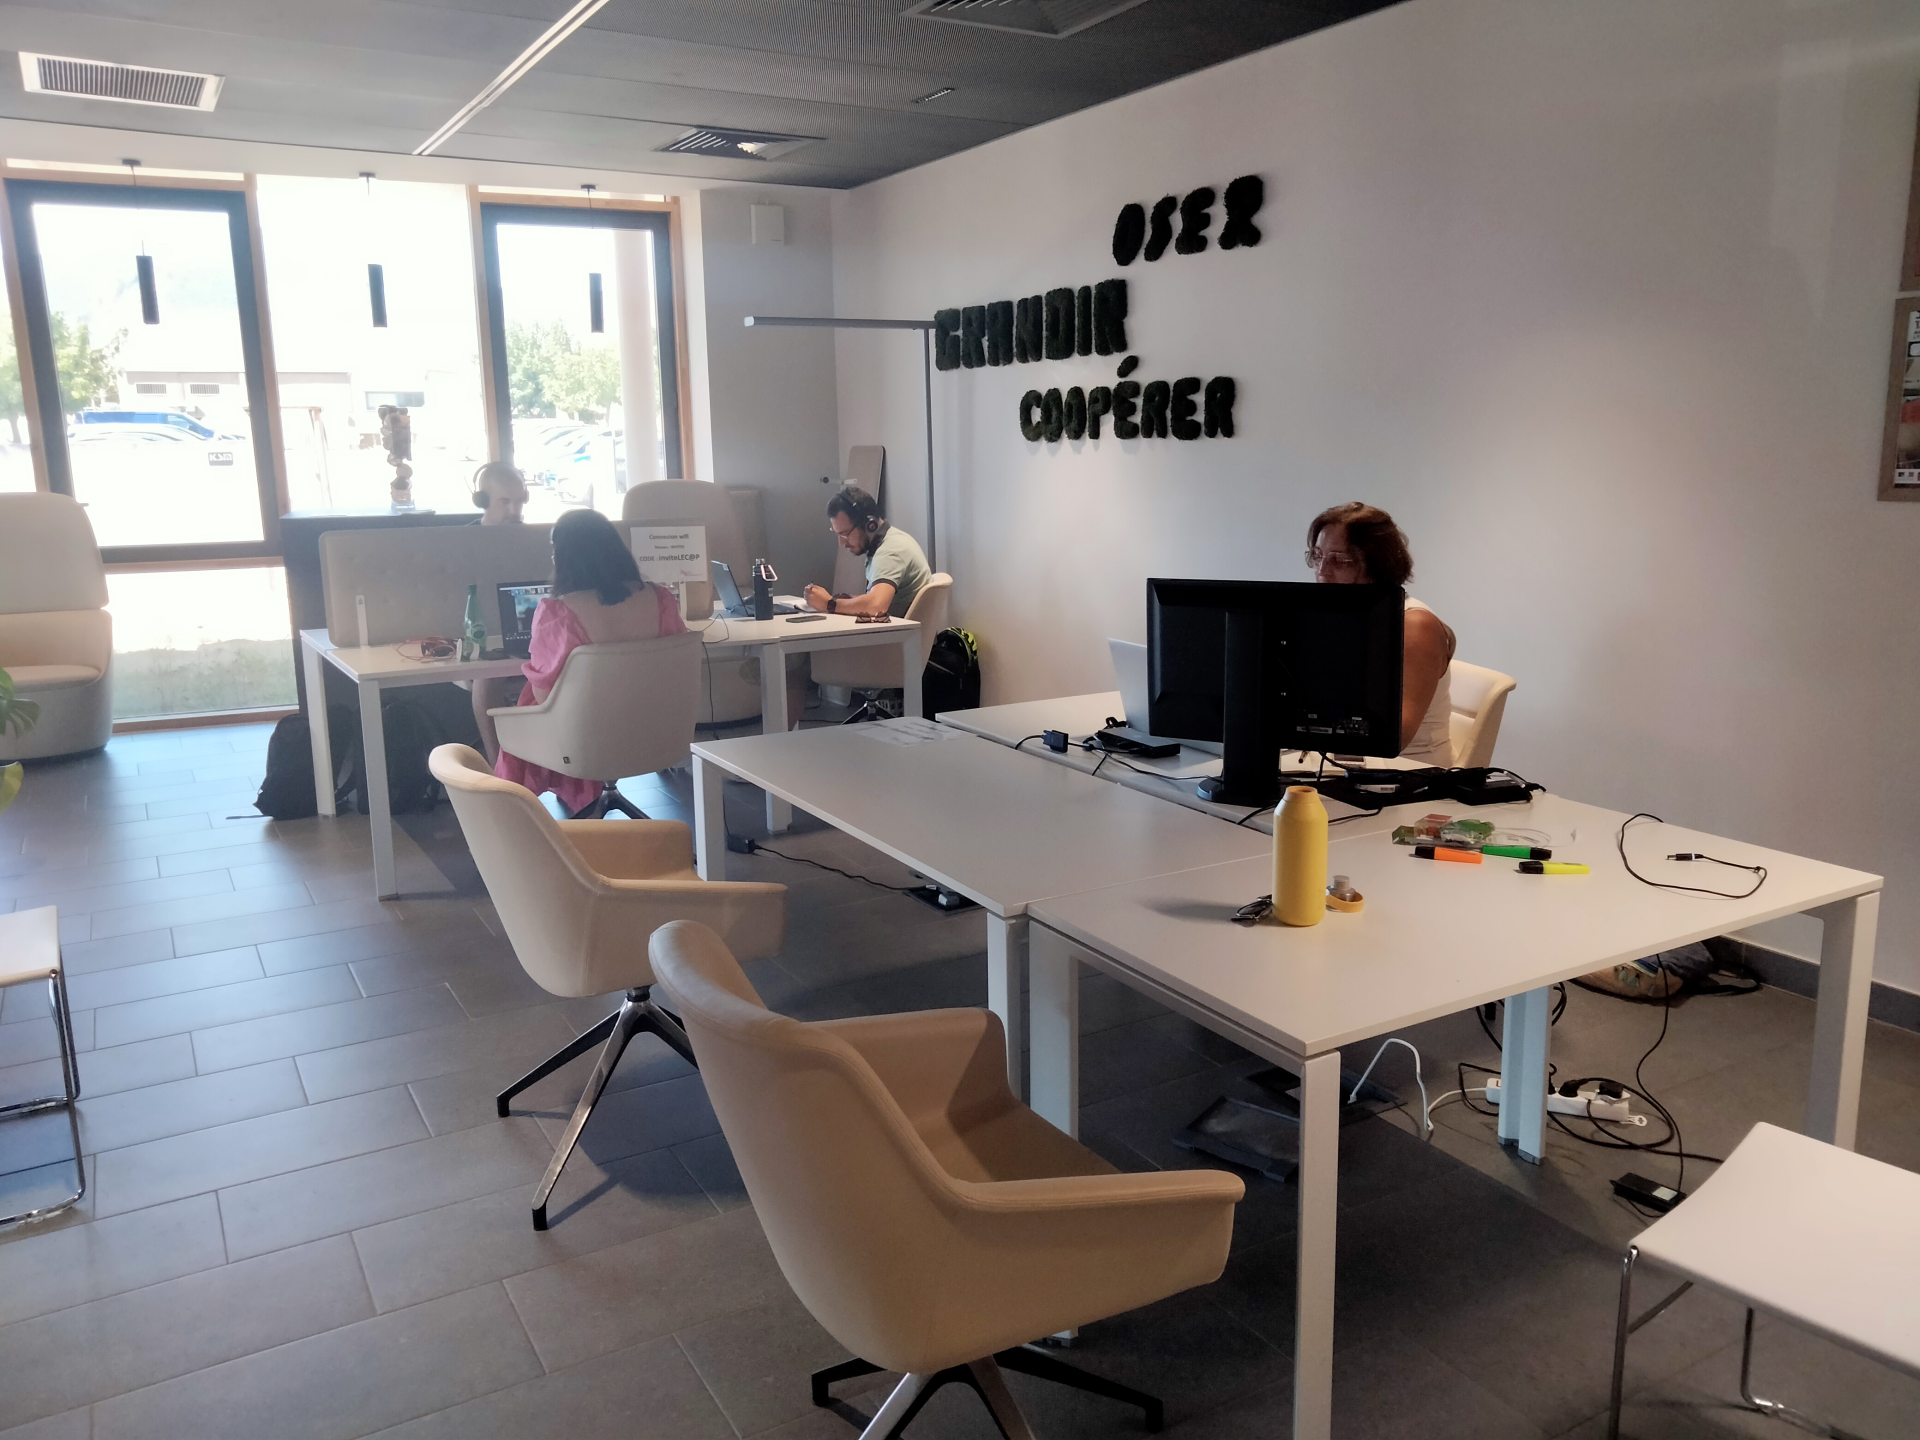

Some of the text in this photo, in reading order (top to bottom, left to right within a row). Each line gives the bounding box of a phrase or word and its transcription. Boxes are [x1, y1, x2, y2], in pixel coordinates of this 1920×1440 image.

[1112, 175, 1263, 266] OSER
[934, 278, 1127, 371] GRANDIR
[1019, 355, 1236, 443] COOPÉRER
